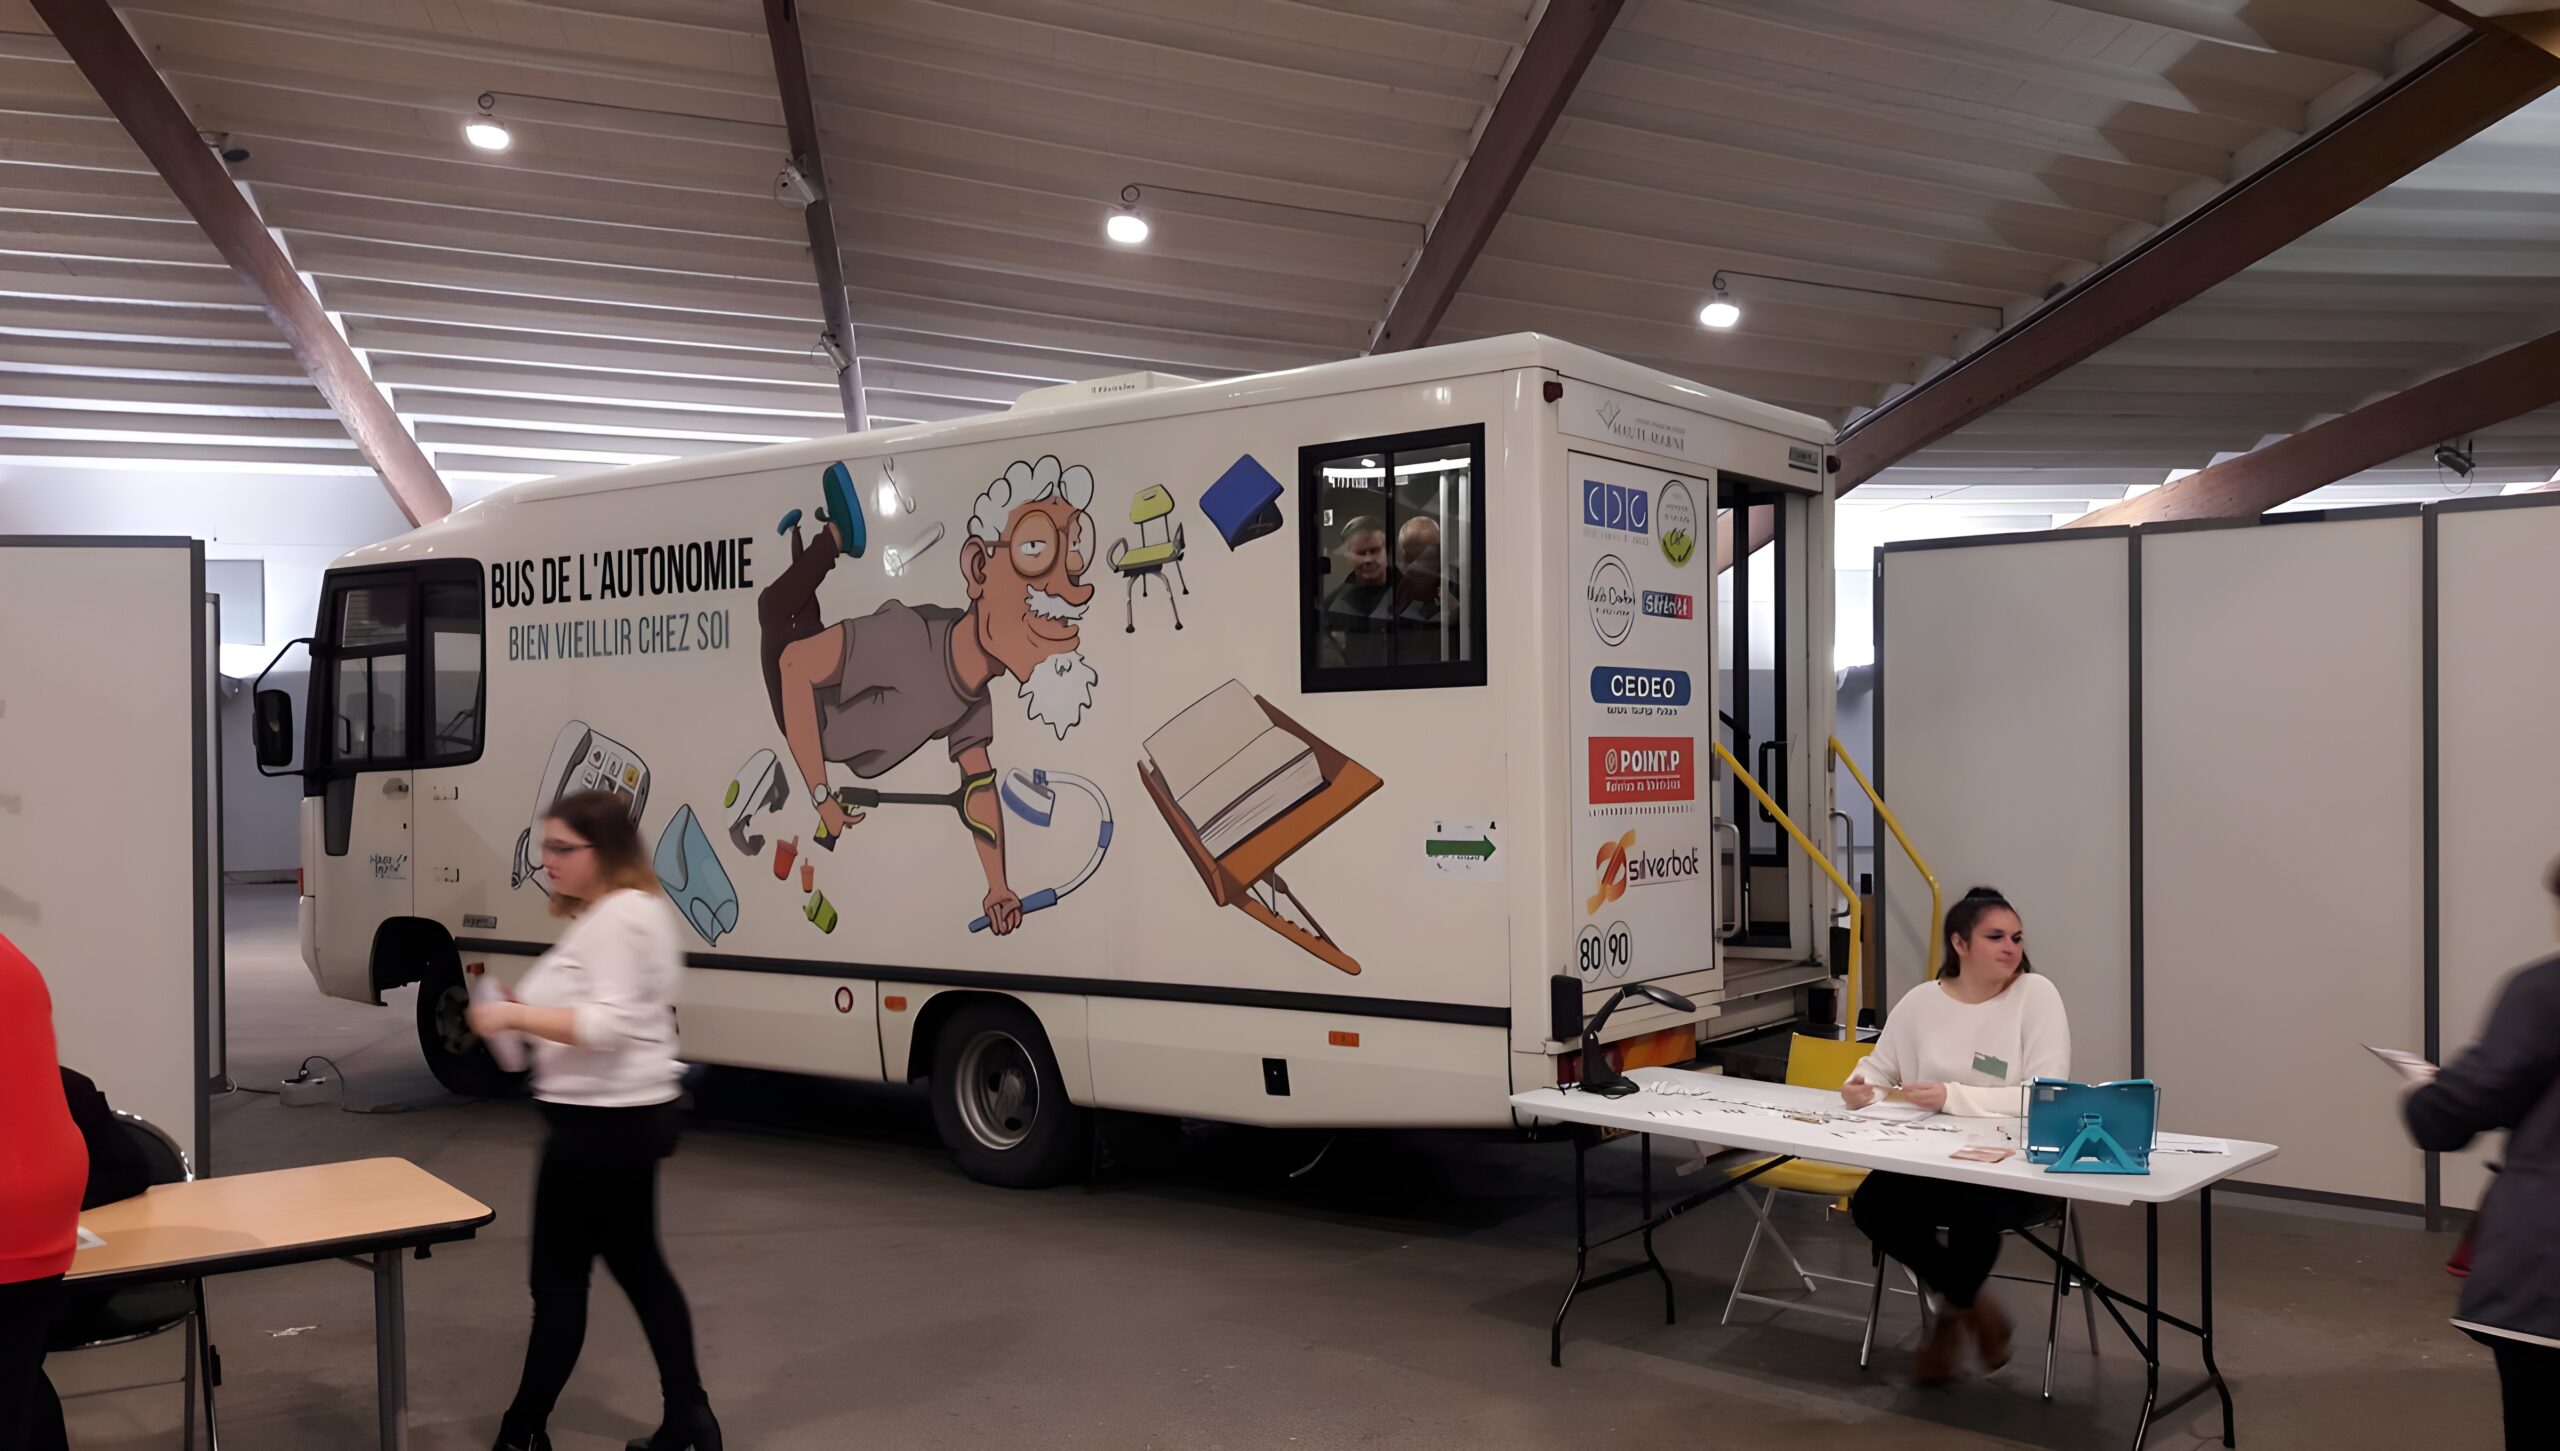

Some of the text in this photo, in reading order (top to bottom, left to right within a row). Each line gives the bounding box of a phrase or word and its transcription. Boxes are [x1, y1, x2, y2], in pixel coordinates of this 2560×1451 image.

[491, 537, 753, 609] BUS DE L'AUTONOMIE
[509, 609, 729, 661] BIEN VIEILLIR CHEZ SOI
[1610, 675, 1676, 699] CEDEO
[1580, 936, 1601, 972] 80
[1609, 932, 1629, 967] 90
